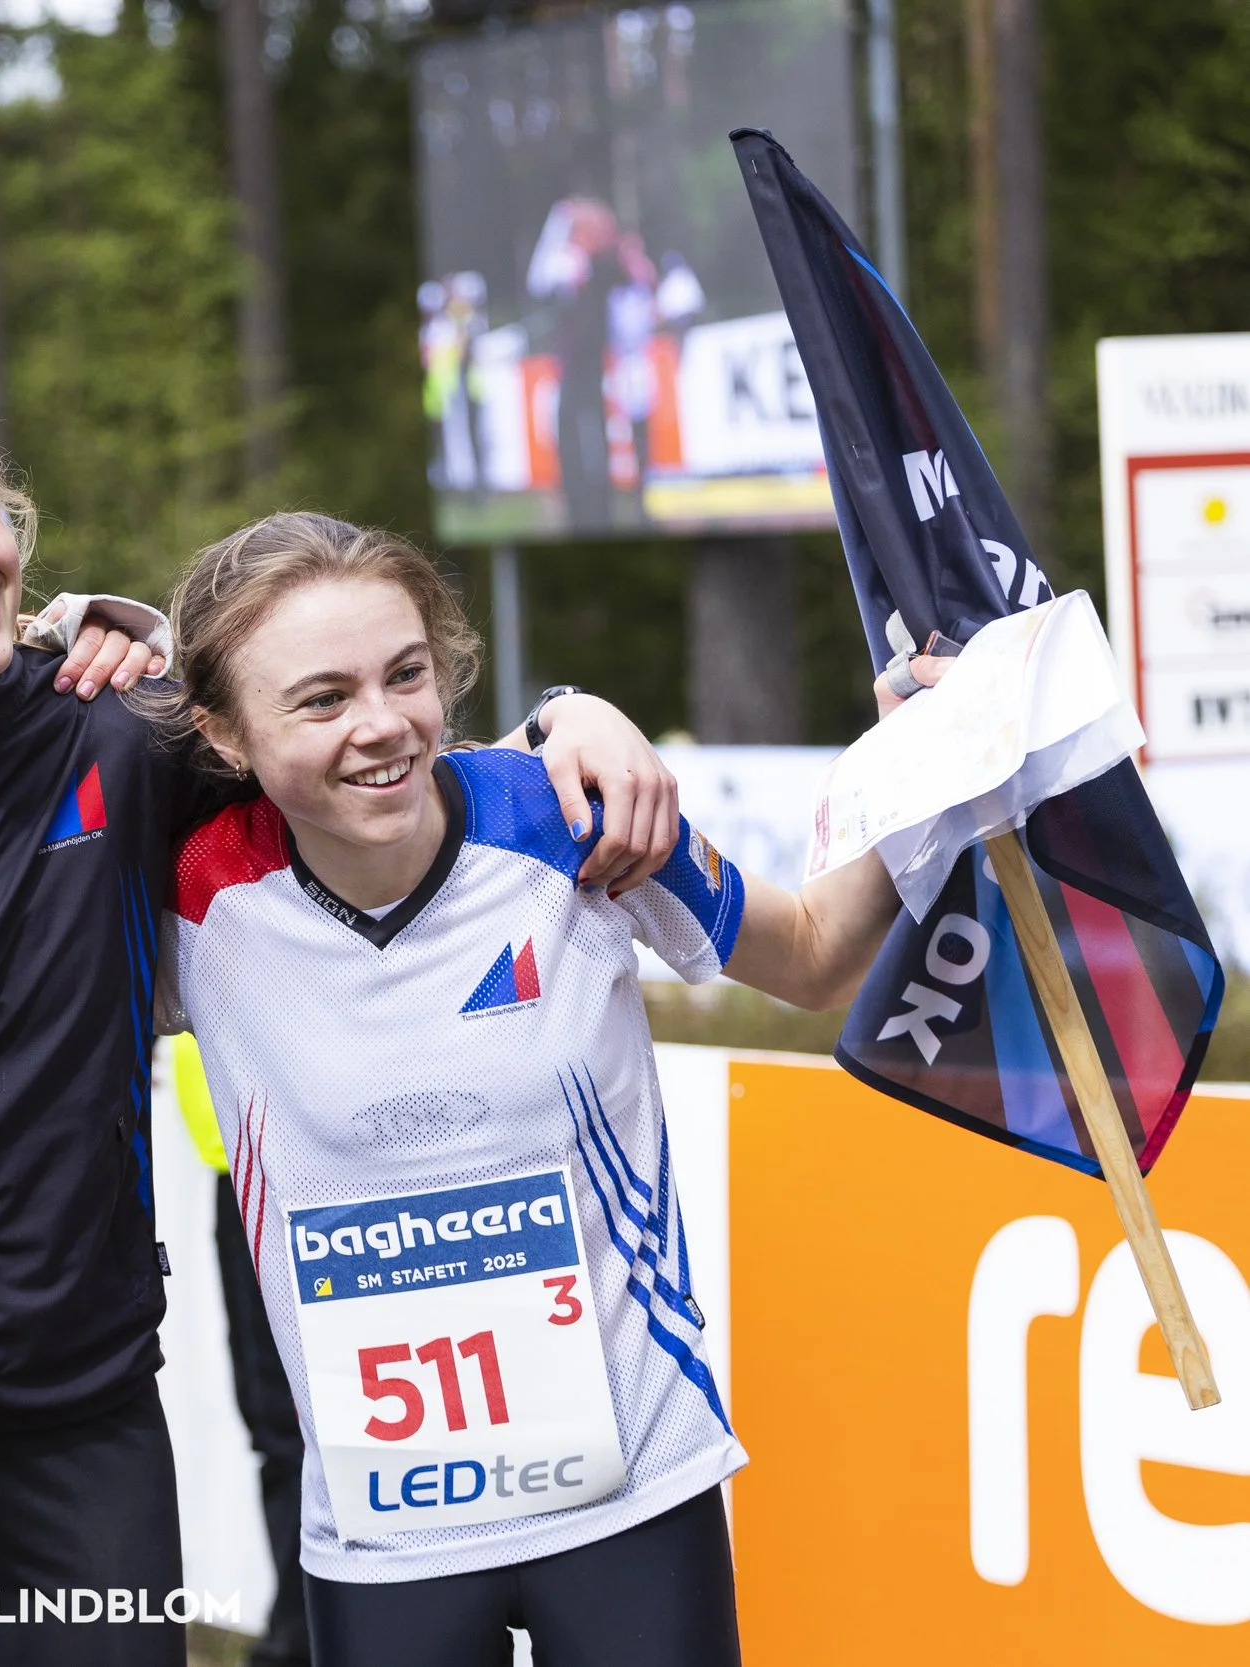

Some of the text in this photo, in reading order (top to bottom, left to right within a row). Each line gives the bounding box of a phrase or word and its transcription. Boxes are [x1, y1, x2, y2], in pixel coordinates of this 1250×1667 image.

[91, 829, 104, 840] OK
[526, 1000, 538, 1010] OK
[876, 913, 991, 1066] OK
[295, 1194, 566, 1259] bagheera
[357, 1251, 527, 1290] SM STAFETT 2025
[542, 1273, 583, 1326] 3
[357, 1330, 510, 1442] 511
[967, 1215, 1250, 1626] re
[368, 1454, 585, 1512] LEDtec
